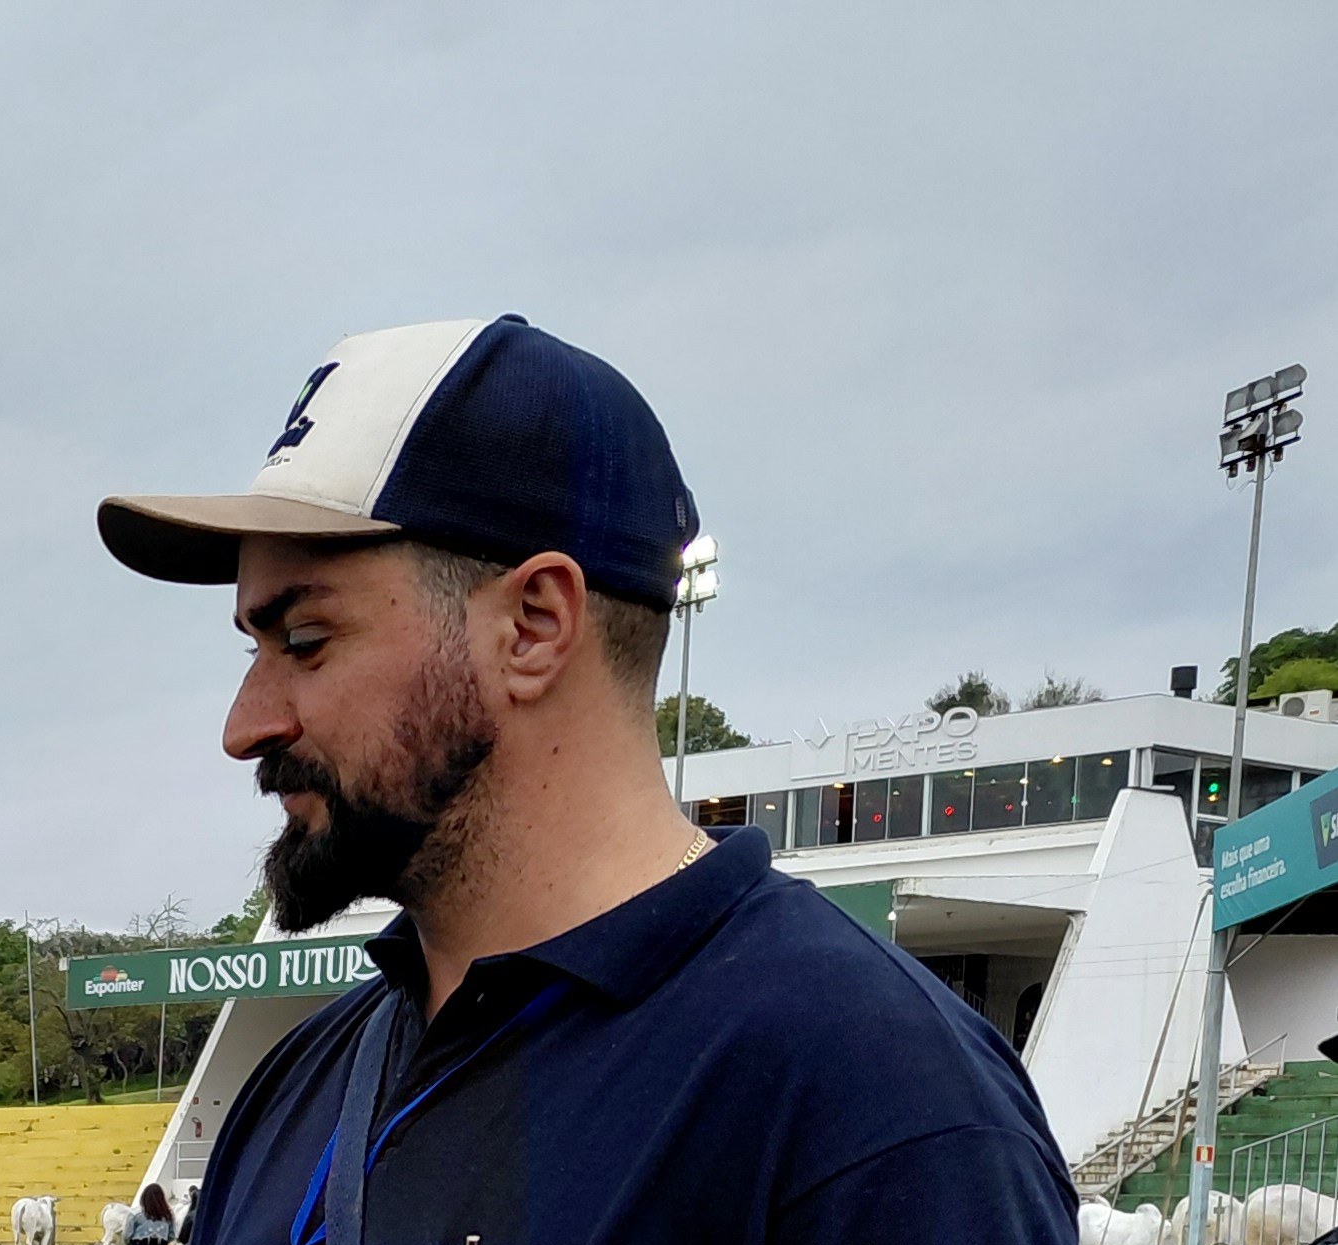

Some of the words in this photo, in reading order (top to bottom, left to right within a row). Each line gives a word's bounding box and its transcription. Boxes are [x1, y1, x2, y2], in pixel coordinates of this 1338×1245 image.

[852, 706, 978, 751] EXPO
[852, 742, 978, 774] MENTES
[1221, 845, 1239, 870] Mais
[1239, 843, 1253, 867] que
[1253, 835, 1271, 856] uma
[1220, 872, 1247, 900] escolha
[84, 976, 145, 998] Expointer
[168, 952, 267, 994] NOSSO
